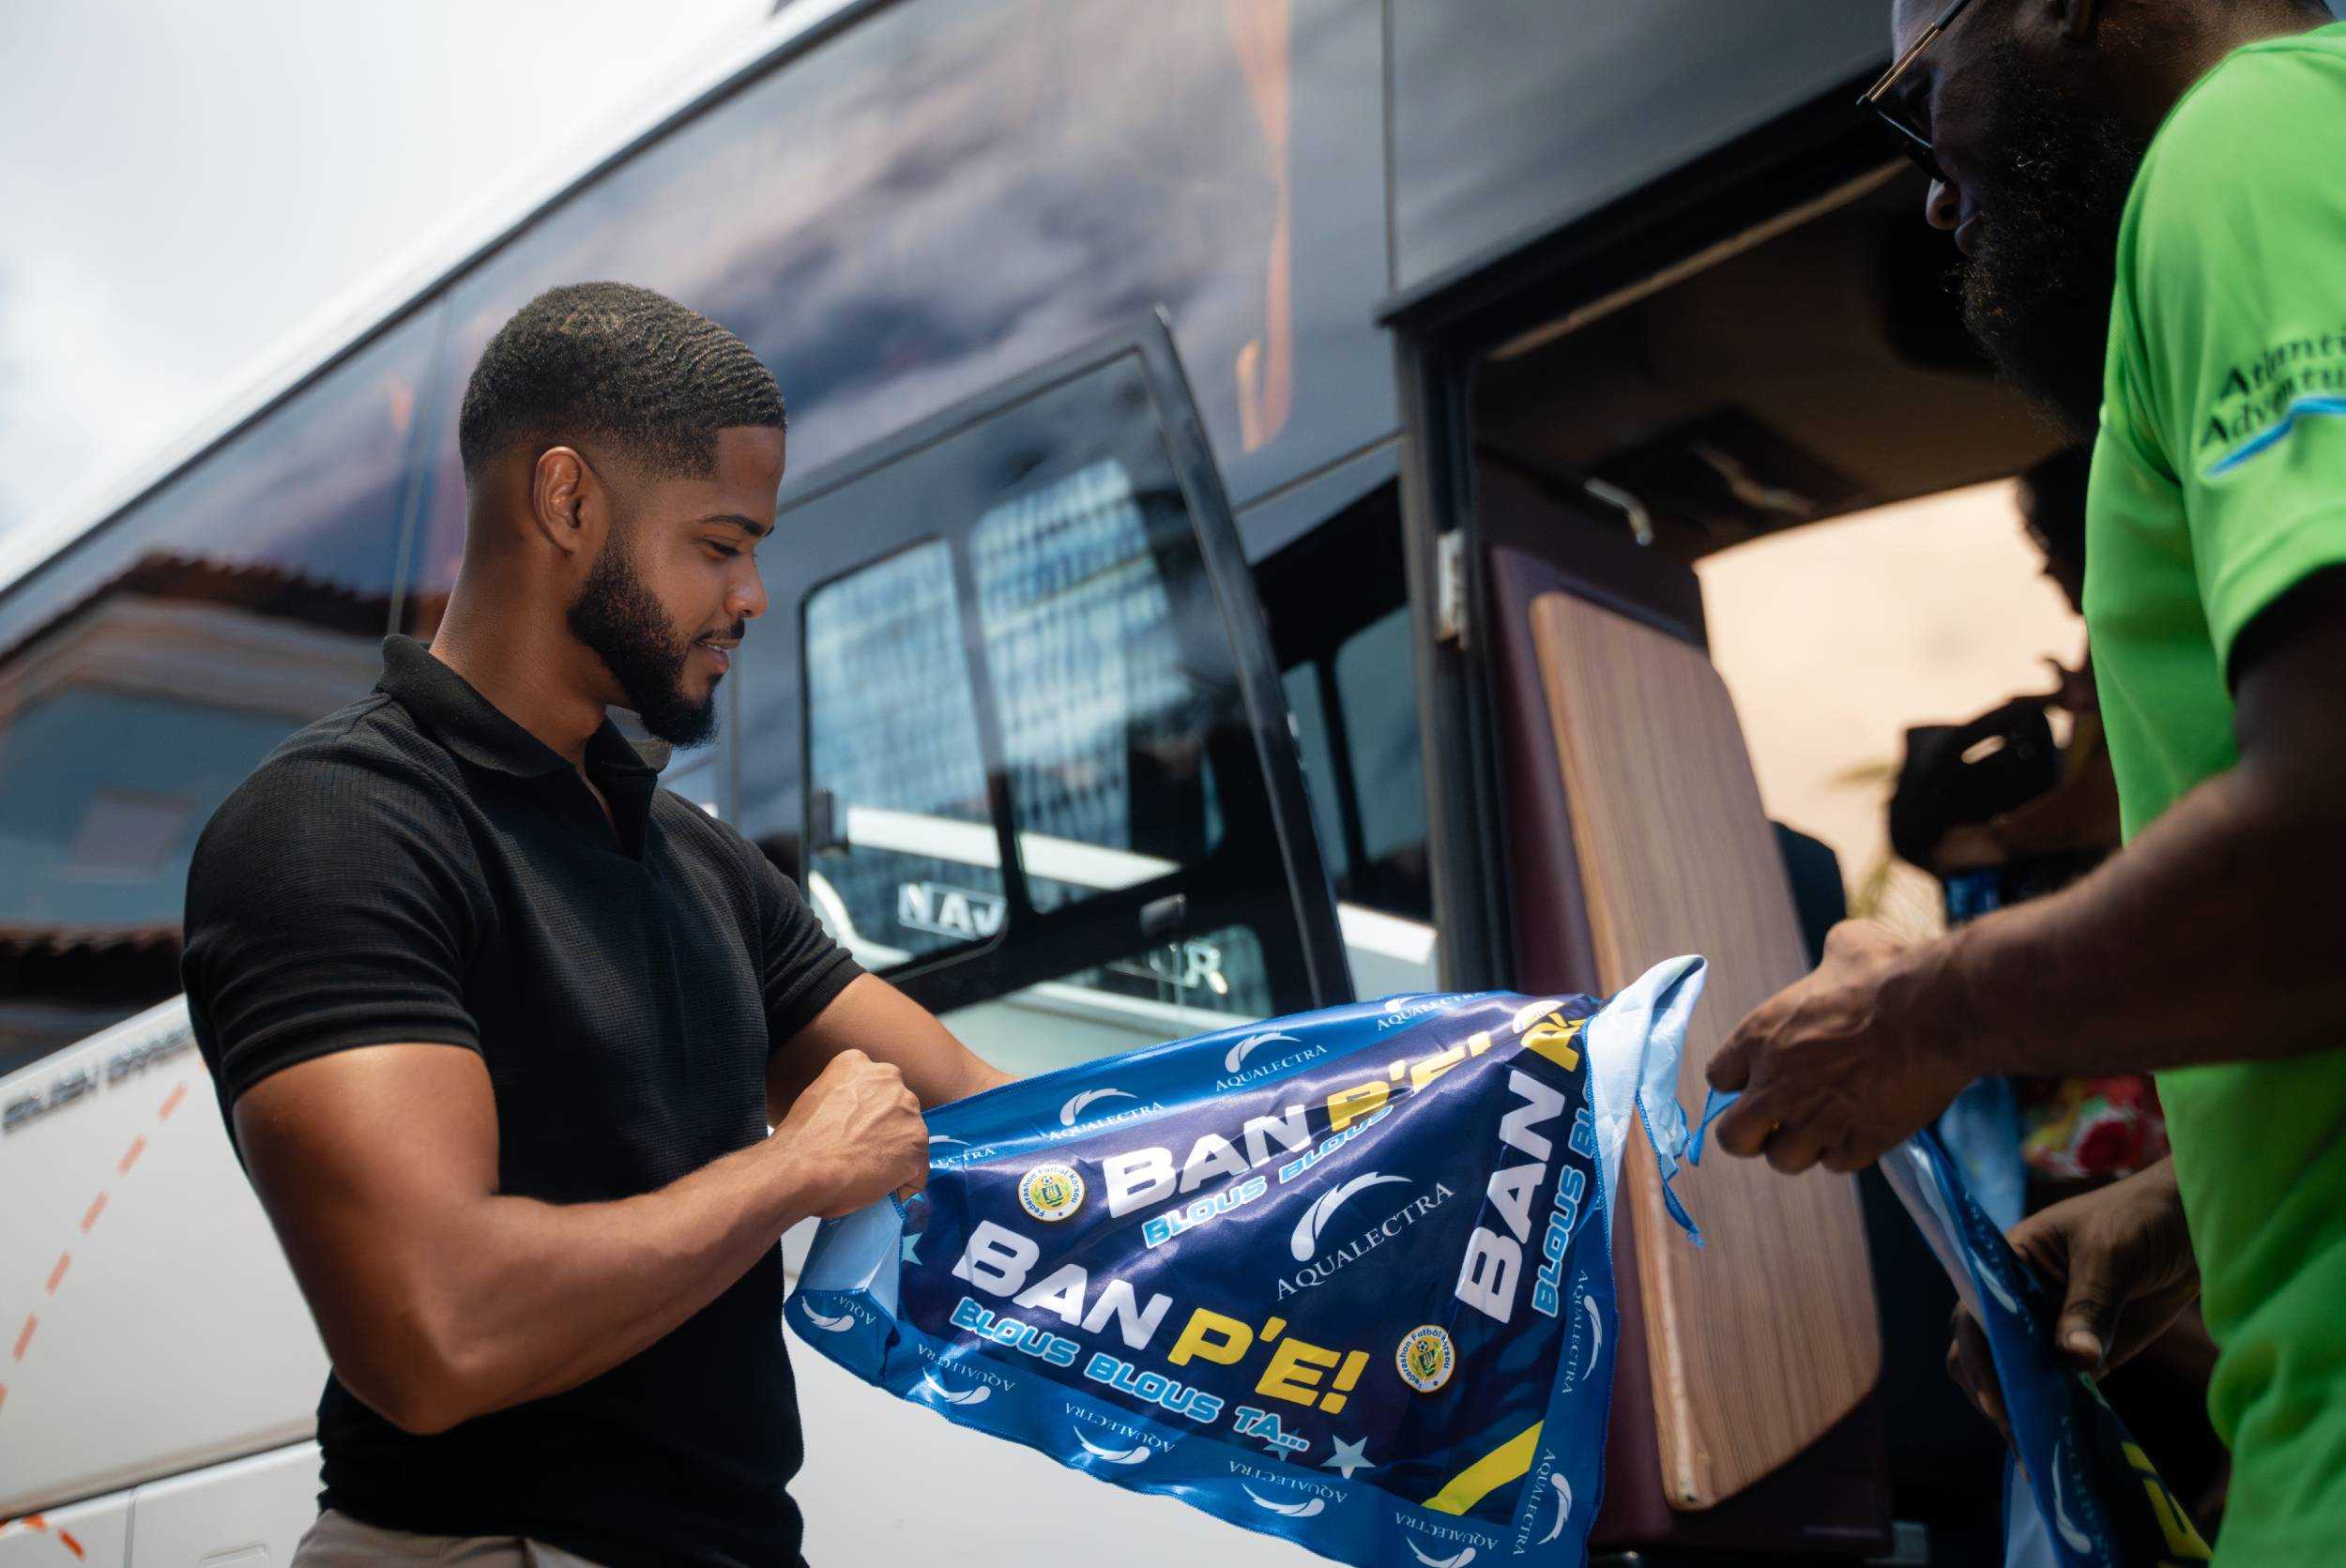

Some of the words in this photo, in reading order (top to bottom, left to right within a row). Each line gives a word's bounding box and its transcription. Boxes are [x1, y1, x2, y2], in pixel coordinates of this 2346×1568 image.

[1048, 1102, 1165, 1141] AQUALECTRA
[1215, 1043, 1328, 1092] AQUALECTRA
[1102, 1104, 1313, 1219] BAN
[1141, 1175, 1268, 1249] BLOUS
[1278, 1104, 1394, 1184] BLOUS
[1455, 1068, 1565, 1324] BAN
[1277, 1182, 1455, 1302] AQUALECTRA
[1531, 1165, 1586, 1317] BLOUS
[917, 1343, 1015, 1392] AQUALECTRA
[950, 1297, 1081, 1368] BLOUS
[1084, 1351, 1224, 1423] BLOUS
[1234, 1406, 1310, 1452] TA...
[952, 1219, 1173, 1350] BAN
[1167, 1307, 1370, 1415] P'E!
[1562, 1269, 1589, 1394] AQUALECTRA
[1065, 1402, 1176, 1454] AQUALECTRA
[1229, 1460, 1348, 1503] AQUALECTRA
[1394, 1512, 1499, 1550] AQUALECTRA
[1513, 1449, 1556, 1556] AQUALECTRA
